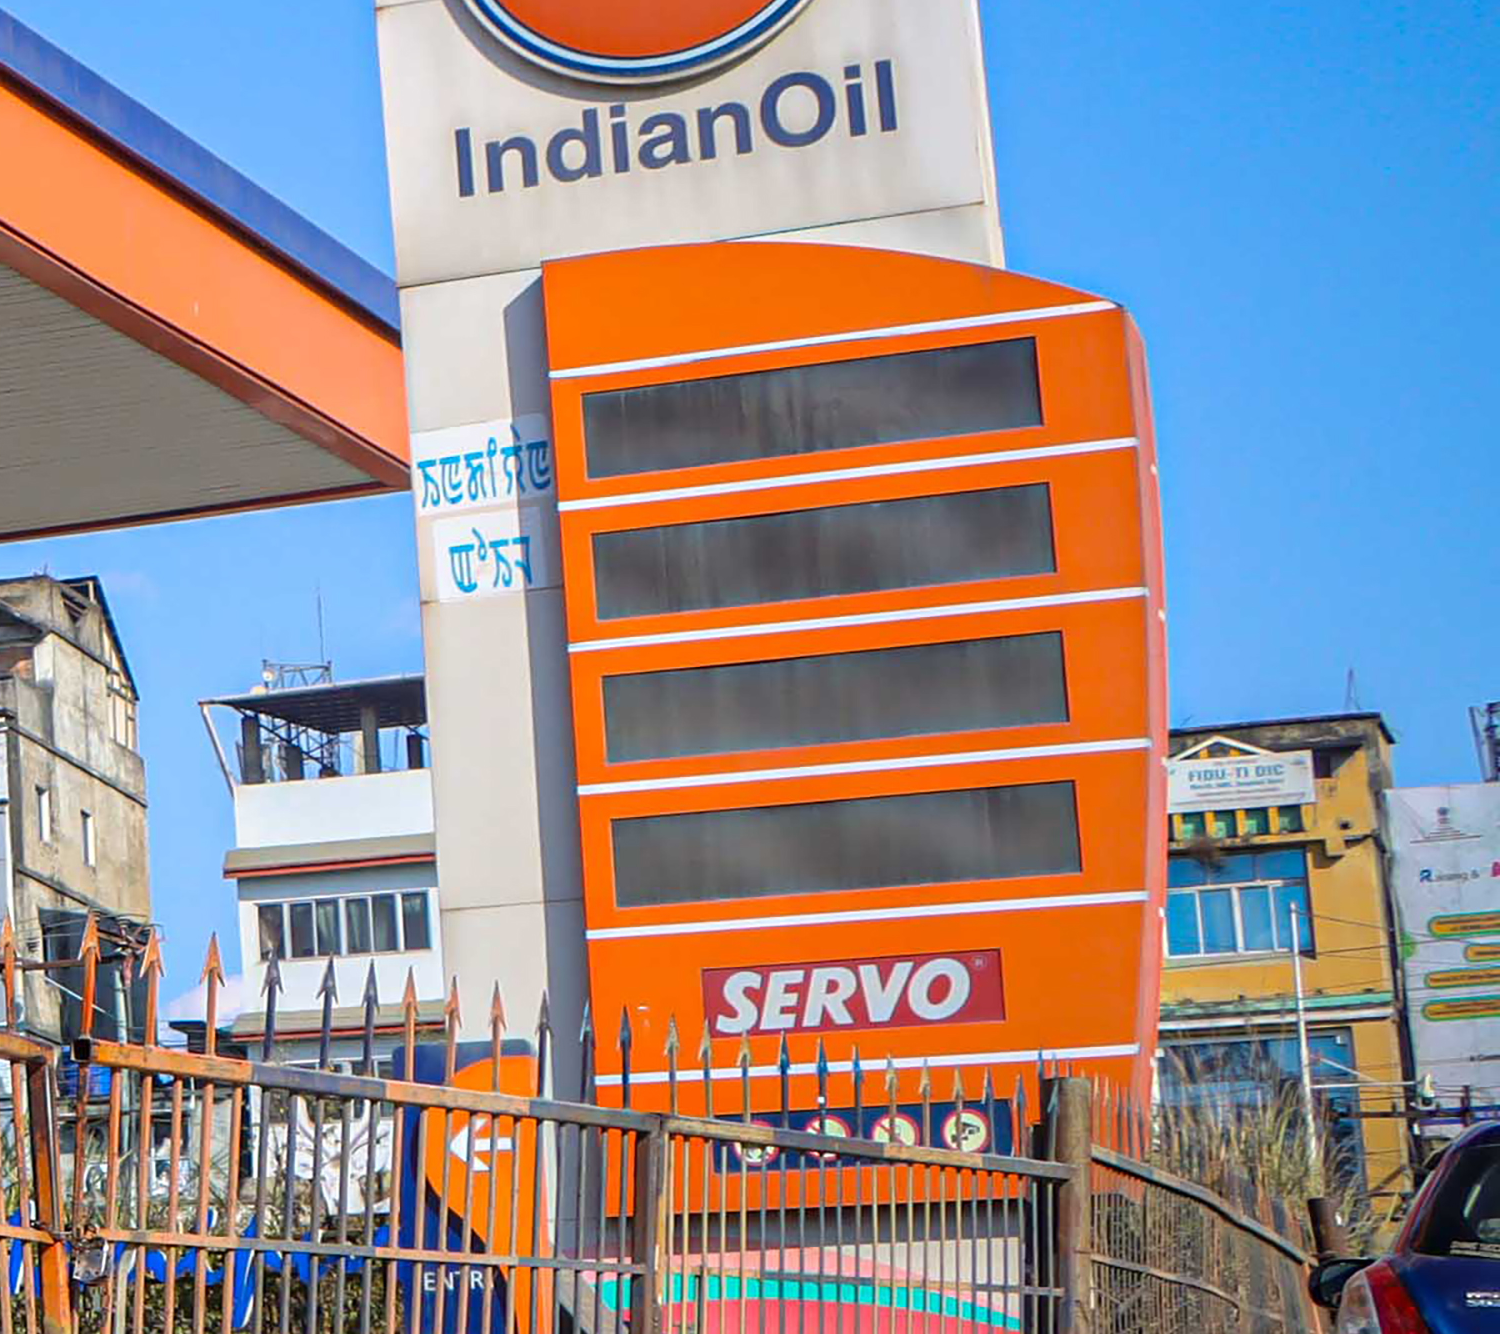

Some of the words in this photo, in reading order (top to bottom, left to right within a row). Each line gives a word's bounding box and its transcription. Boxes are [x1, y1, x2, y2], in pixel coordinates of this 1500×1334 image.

[455, 59, 898, 197] IndianOil
[715, 957, 971, 1033] SERVO
[424, 1270, 485, 1292] ENR
